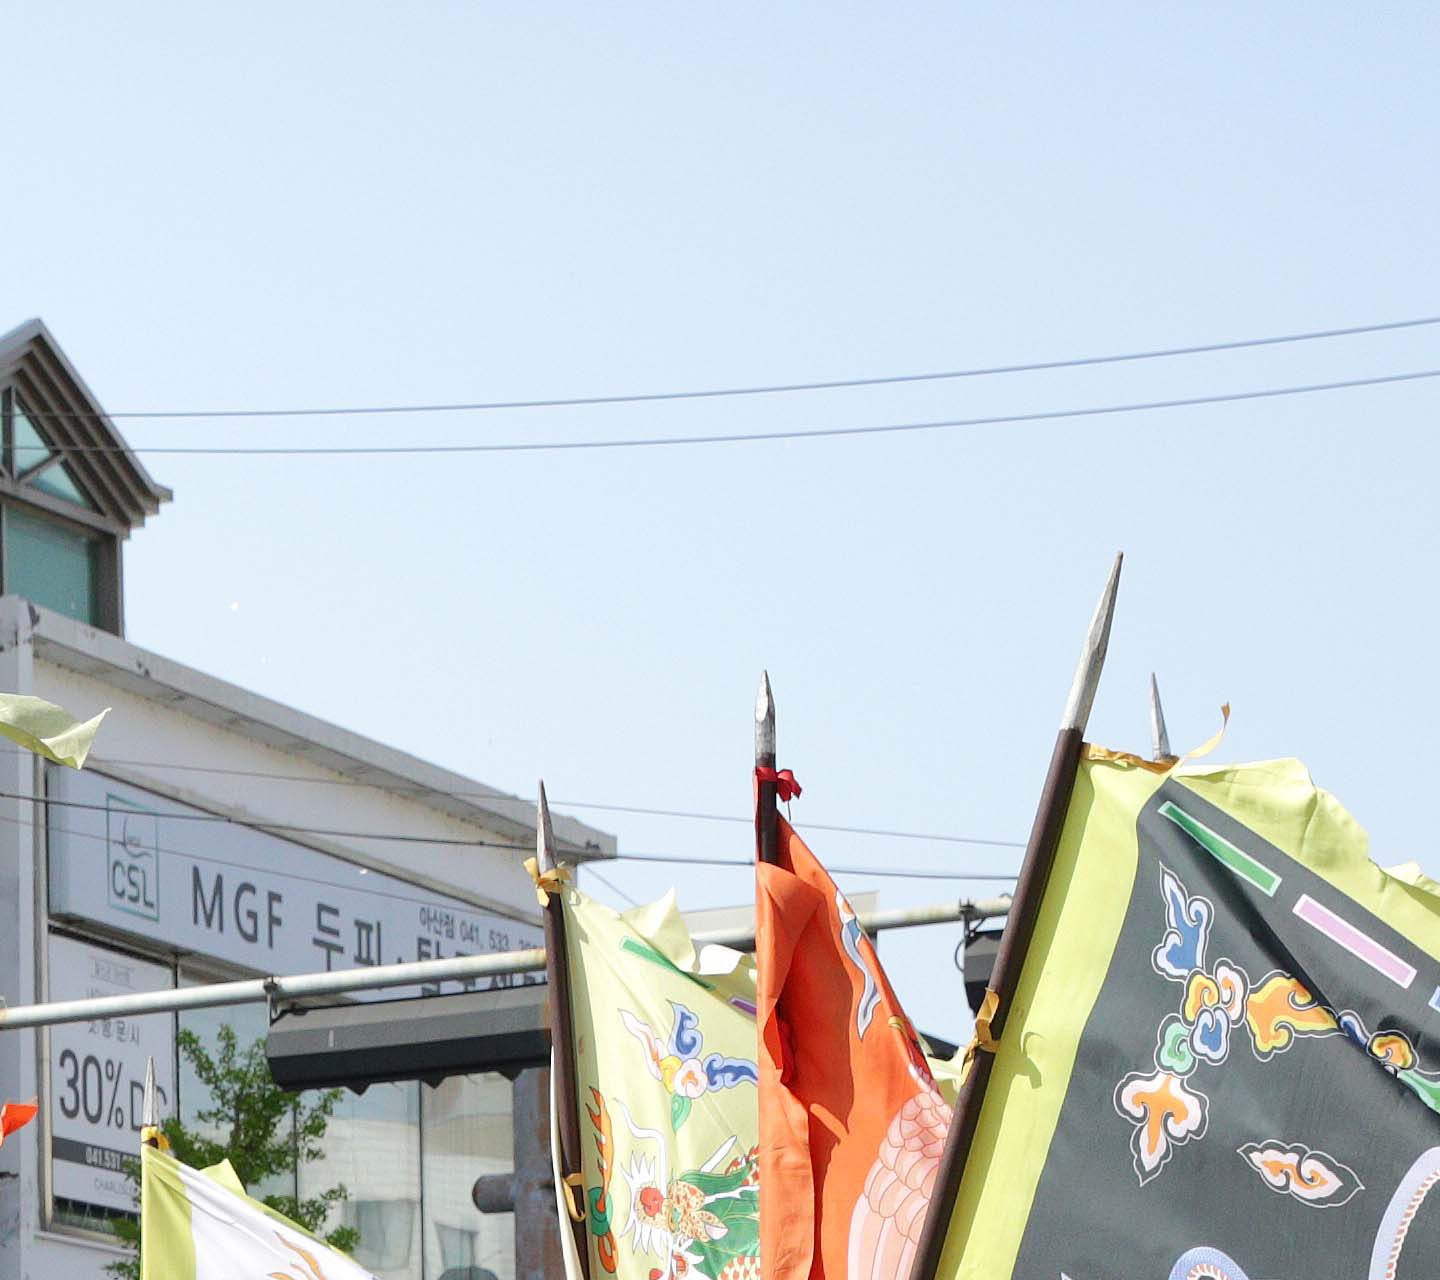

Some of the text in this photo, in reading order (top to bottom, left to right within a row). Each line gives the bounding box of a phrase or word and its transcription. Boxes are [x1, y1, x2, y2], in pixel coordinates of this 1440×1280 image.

[112, 859, 154, 909] CSL
[192, 865, 283, 949] MGF
[59, 1048, 124, 1129] 30%
